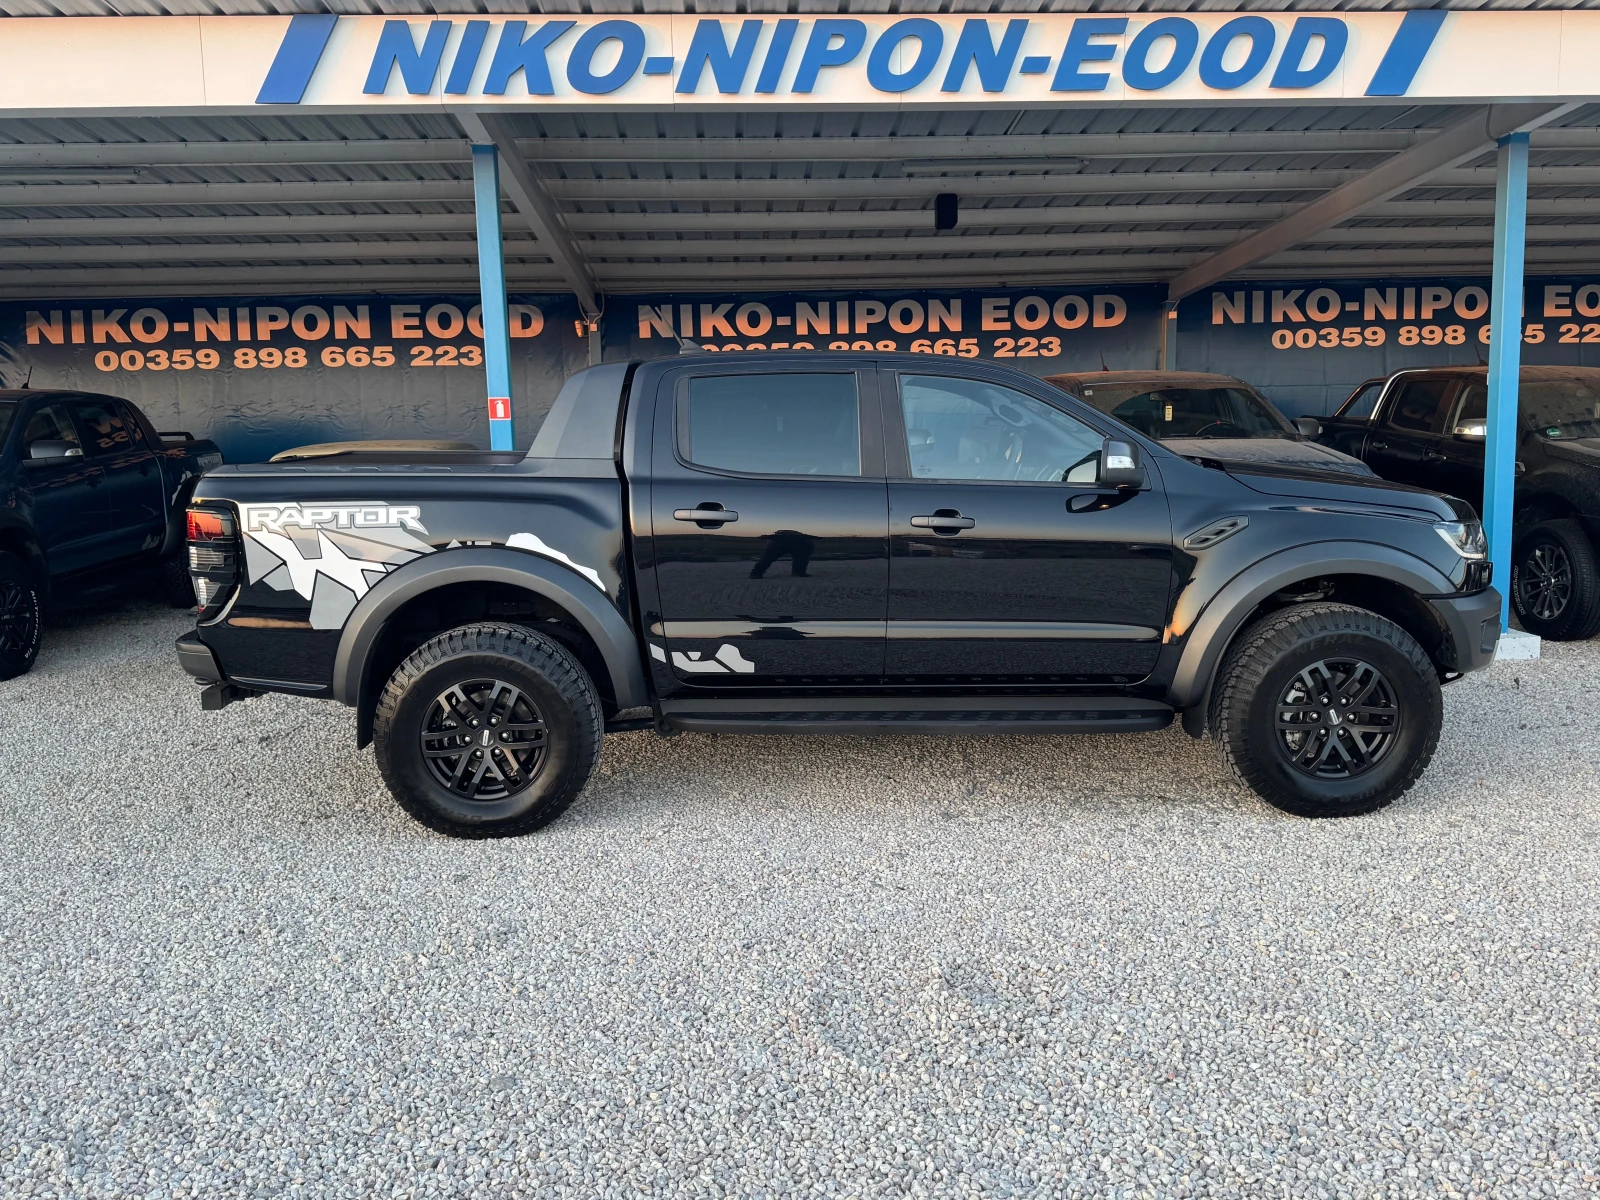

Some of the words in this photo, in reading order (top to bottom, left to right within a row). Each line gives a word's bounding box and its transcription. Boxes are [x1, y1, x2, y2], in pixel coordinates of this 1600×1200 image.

[362, 16, 1349, 95] NIKO-NIPON-EOOD
[26, 303, 372, 345] NIKO-NIPON
[638, 299, 963, 339] NIKO-NIPON
[981, 295, 1128, 332] EOOD
[1212, 286, 1526, 325] NIKO-NIPO
[993, 336, 1062, 358] 223
[1271, 326, 1387, 350] 00359
[1397, 324, 1467, 346] 898
[1477, 323, 1546, 345] 65
[94, 348, 221, 372] 00359
[233, 347, 309, 369] 898
[320, 346, 397, 368] 665
[409, 344, 484, 368] 223
[247, 505, 430, 540] RAPTOR
